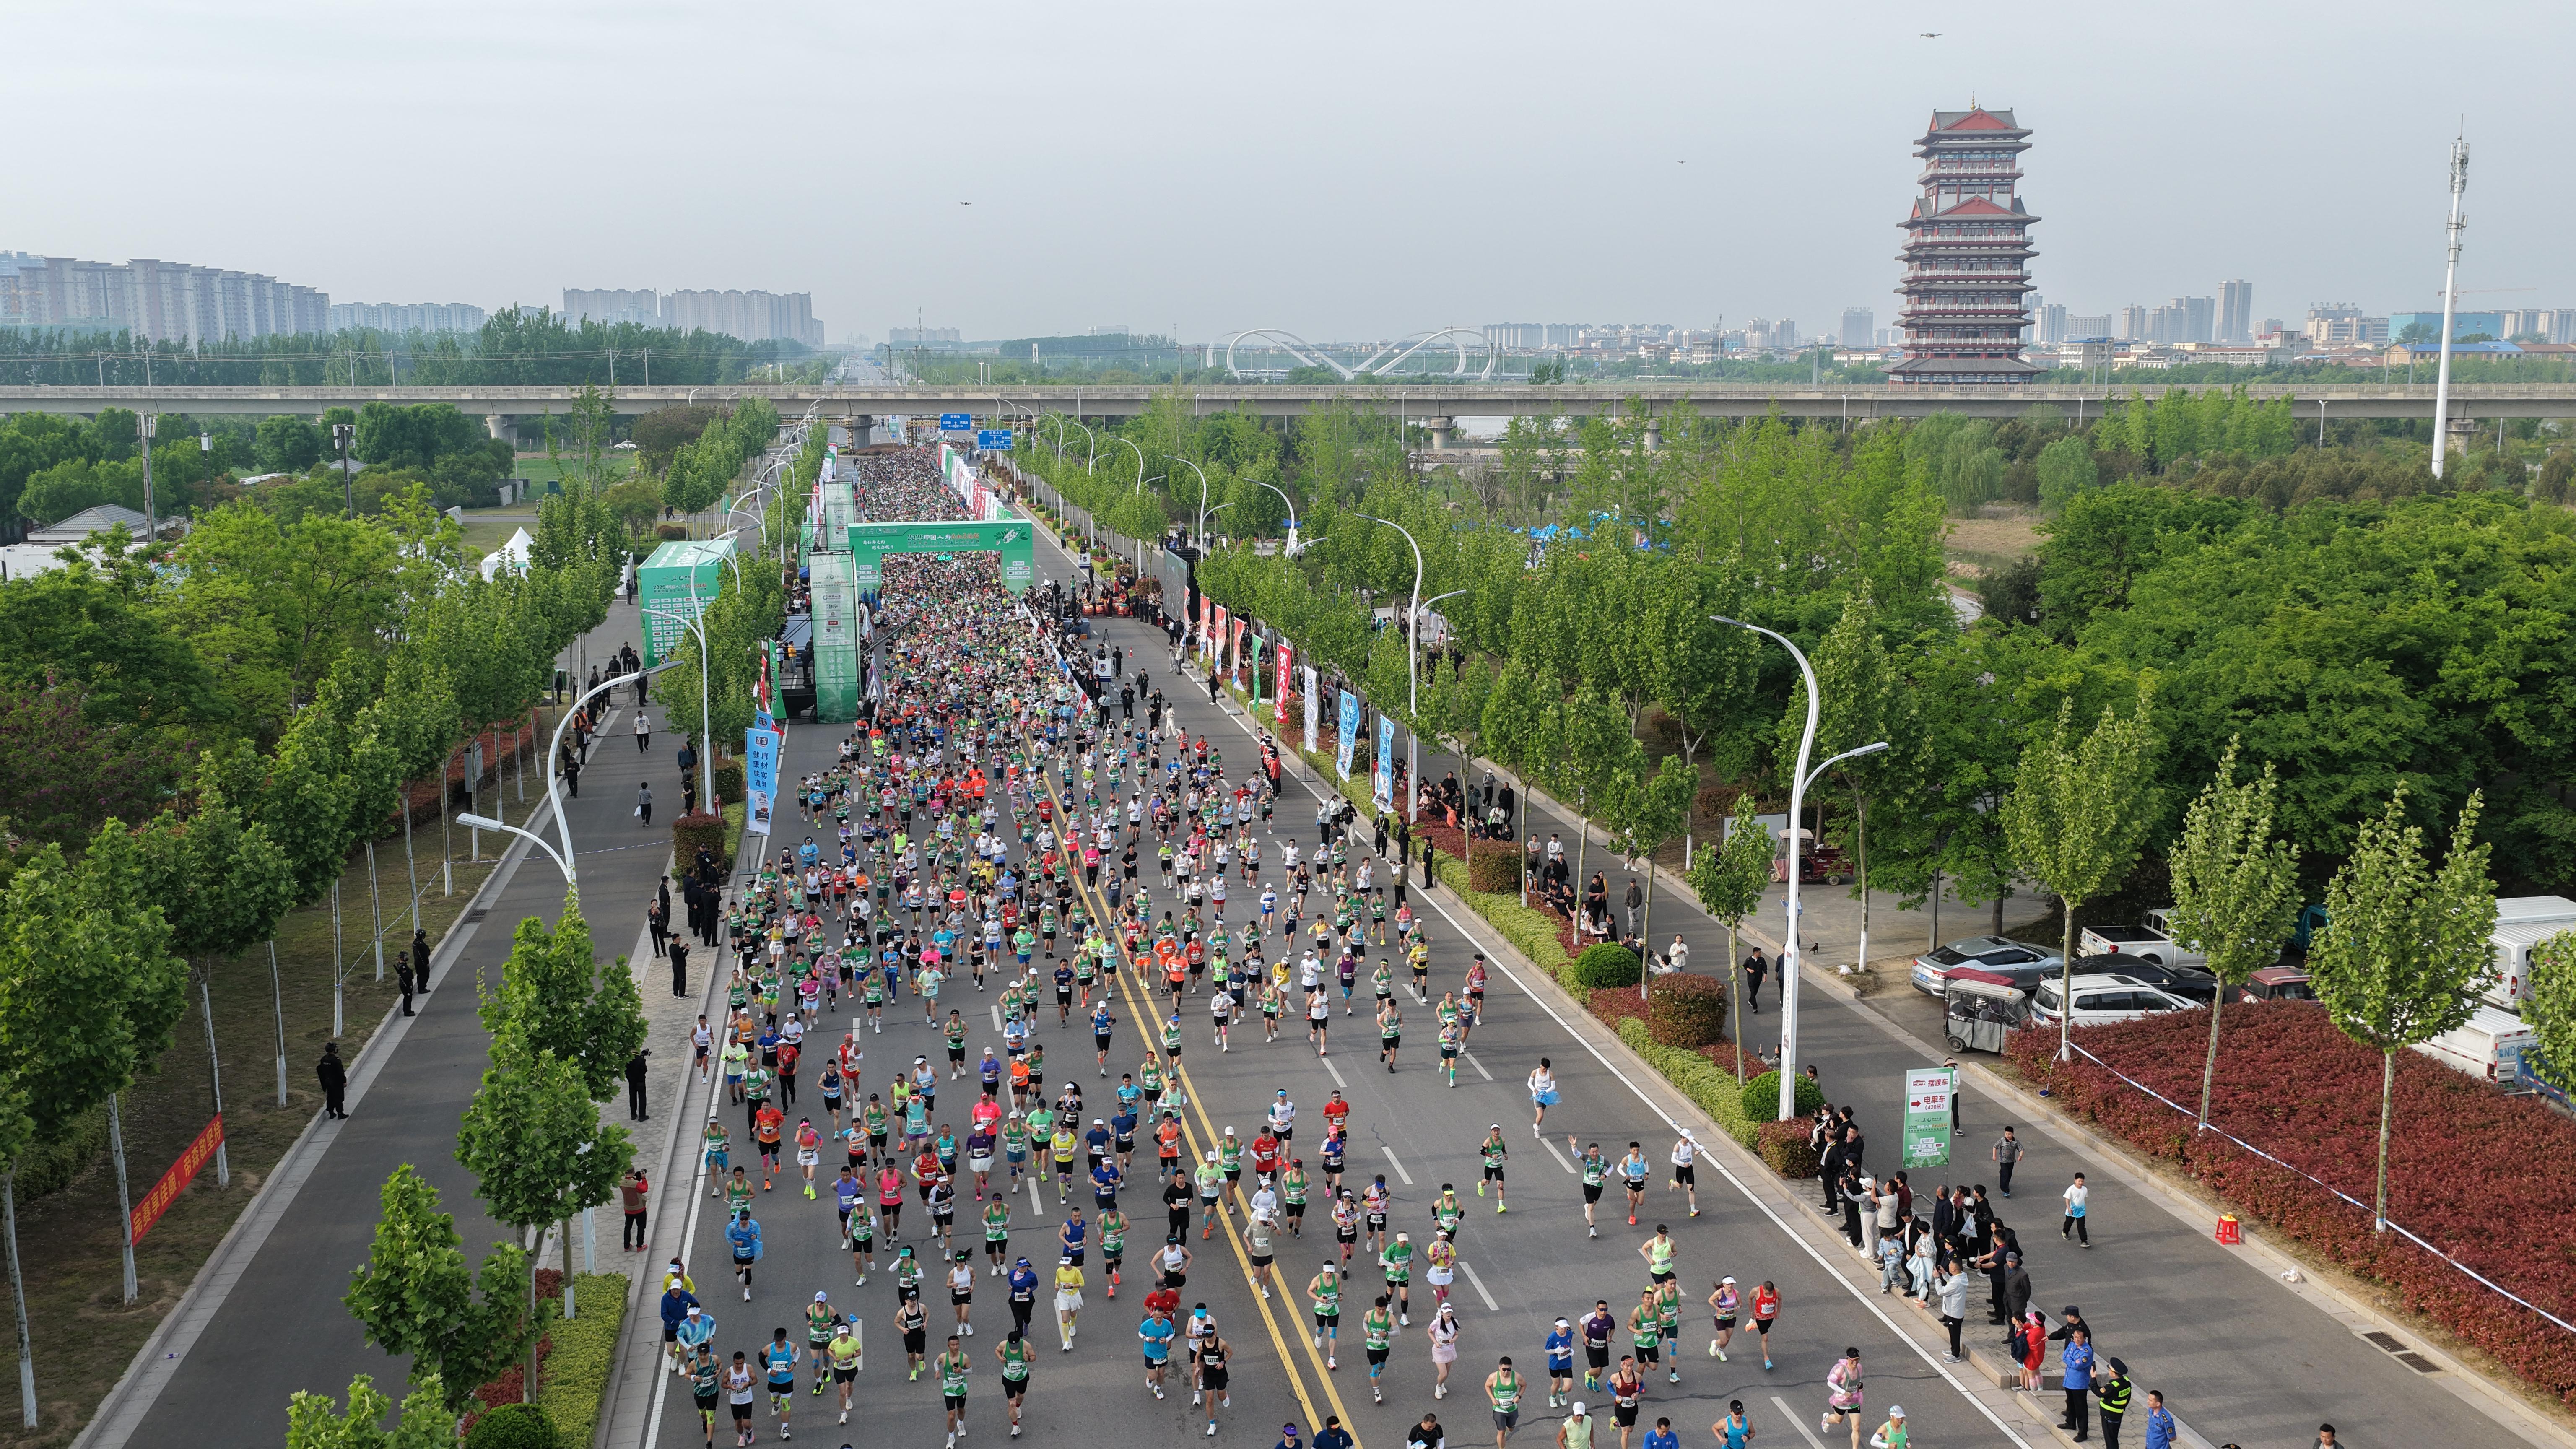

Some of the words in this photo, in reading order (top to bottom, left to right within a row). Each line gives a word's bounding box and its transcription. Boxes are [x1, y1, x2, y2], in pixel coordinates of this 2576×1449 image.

[1928, 1079, 1948, 1088] 摆渡车
[1924, 1095, 1946, 1104] 电单车
